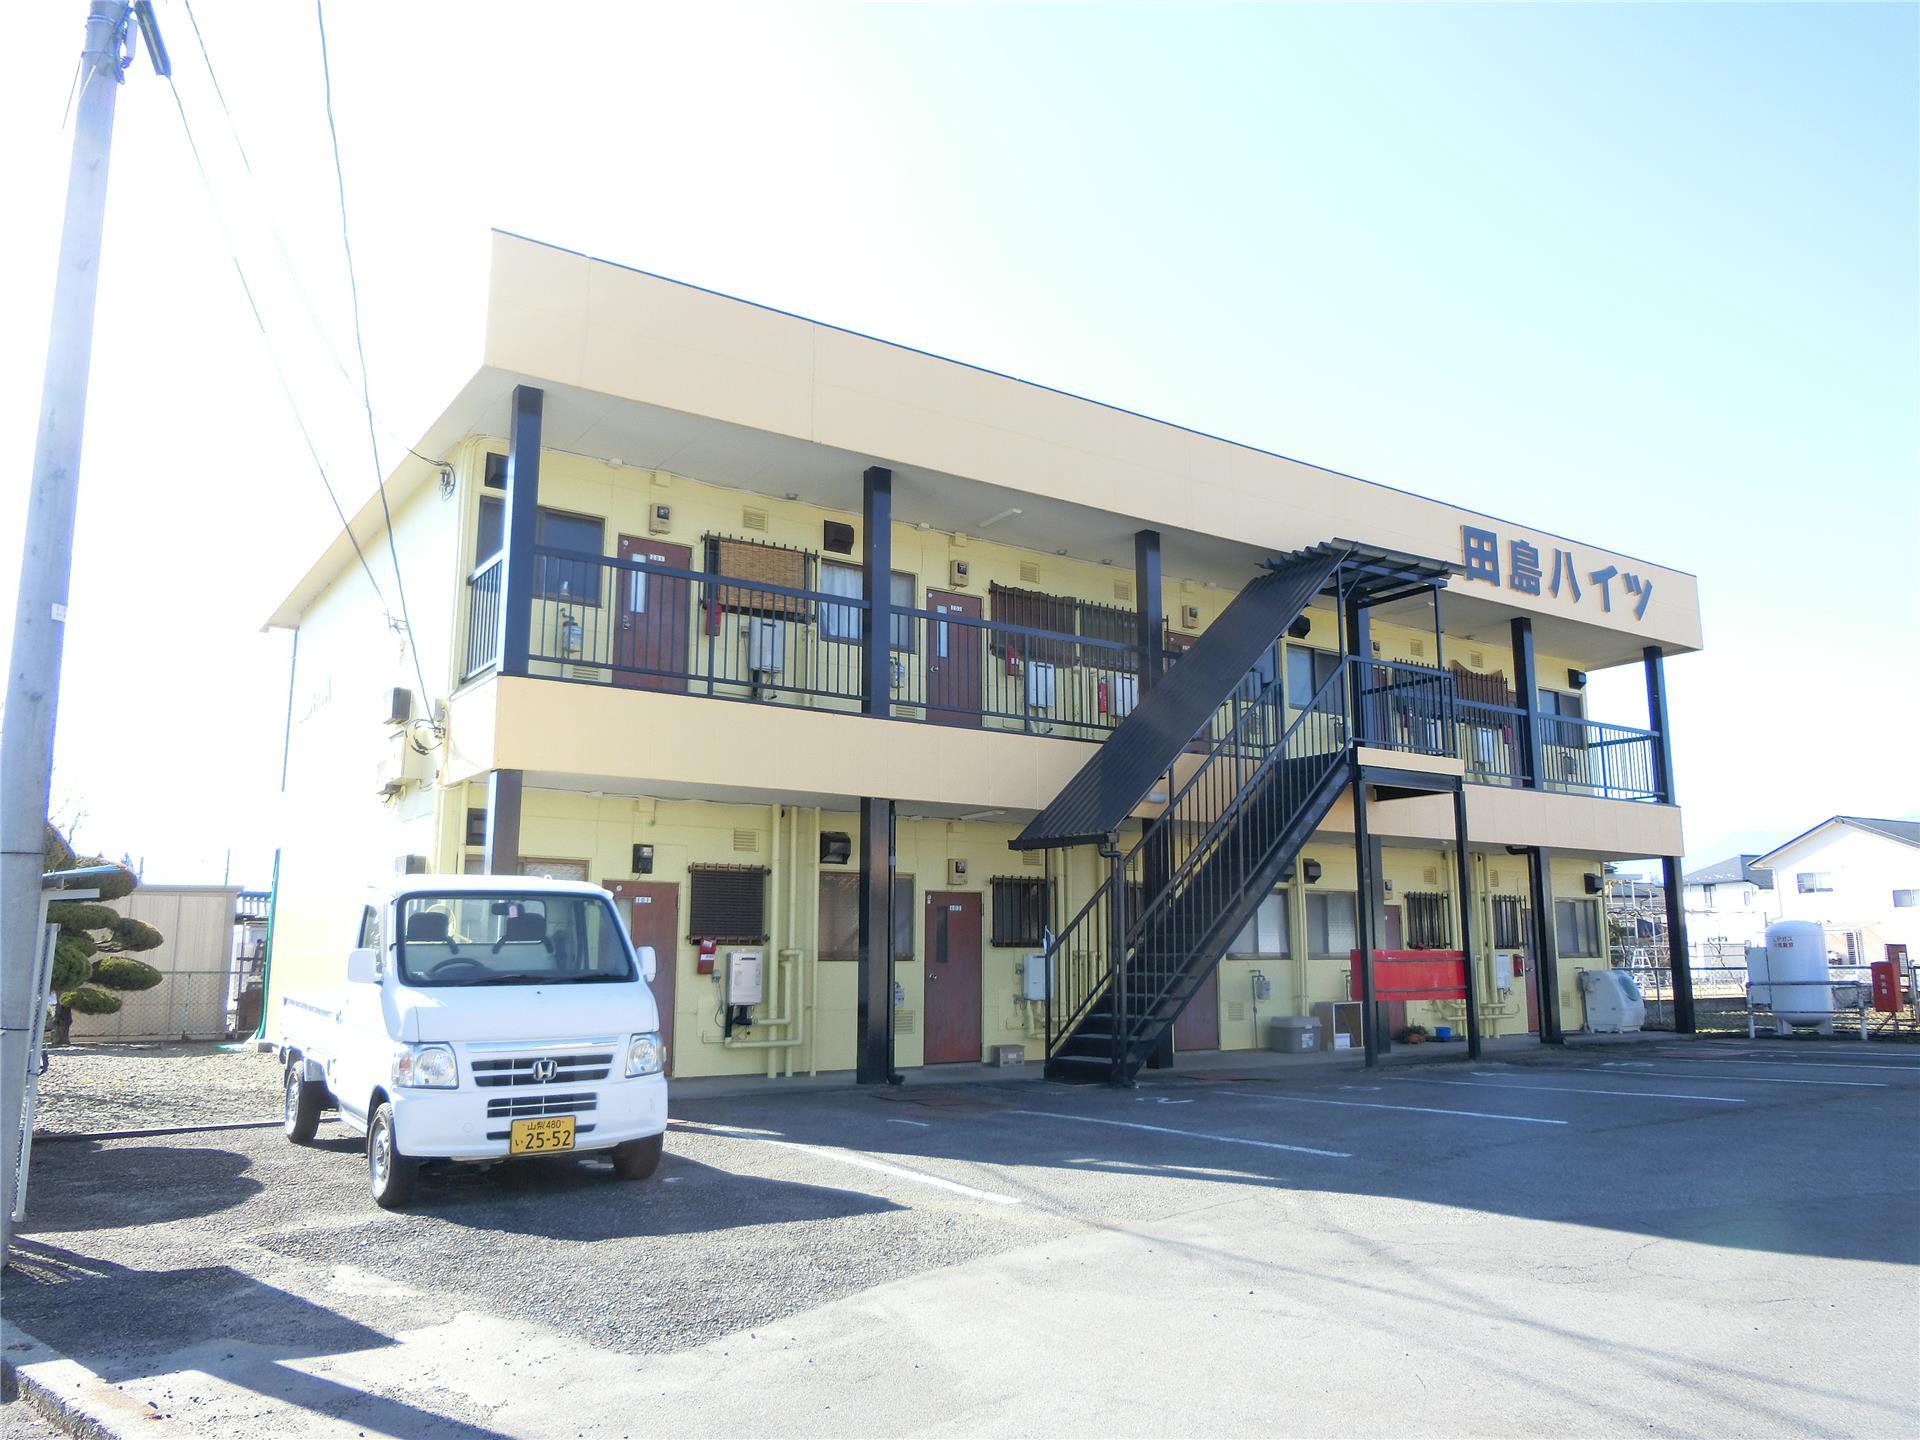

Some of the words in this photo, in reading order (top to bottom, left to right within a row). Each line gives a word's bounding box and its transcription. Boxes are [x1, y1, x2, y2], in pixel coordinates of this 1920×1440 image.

[1460, 524, 1653, 622] 田島ハイツ
[525, 1130, 571, 1150] 25-52
